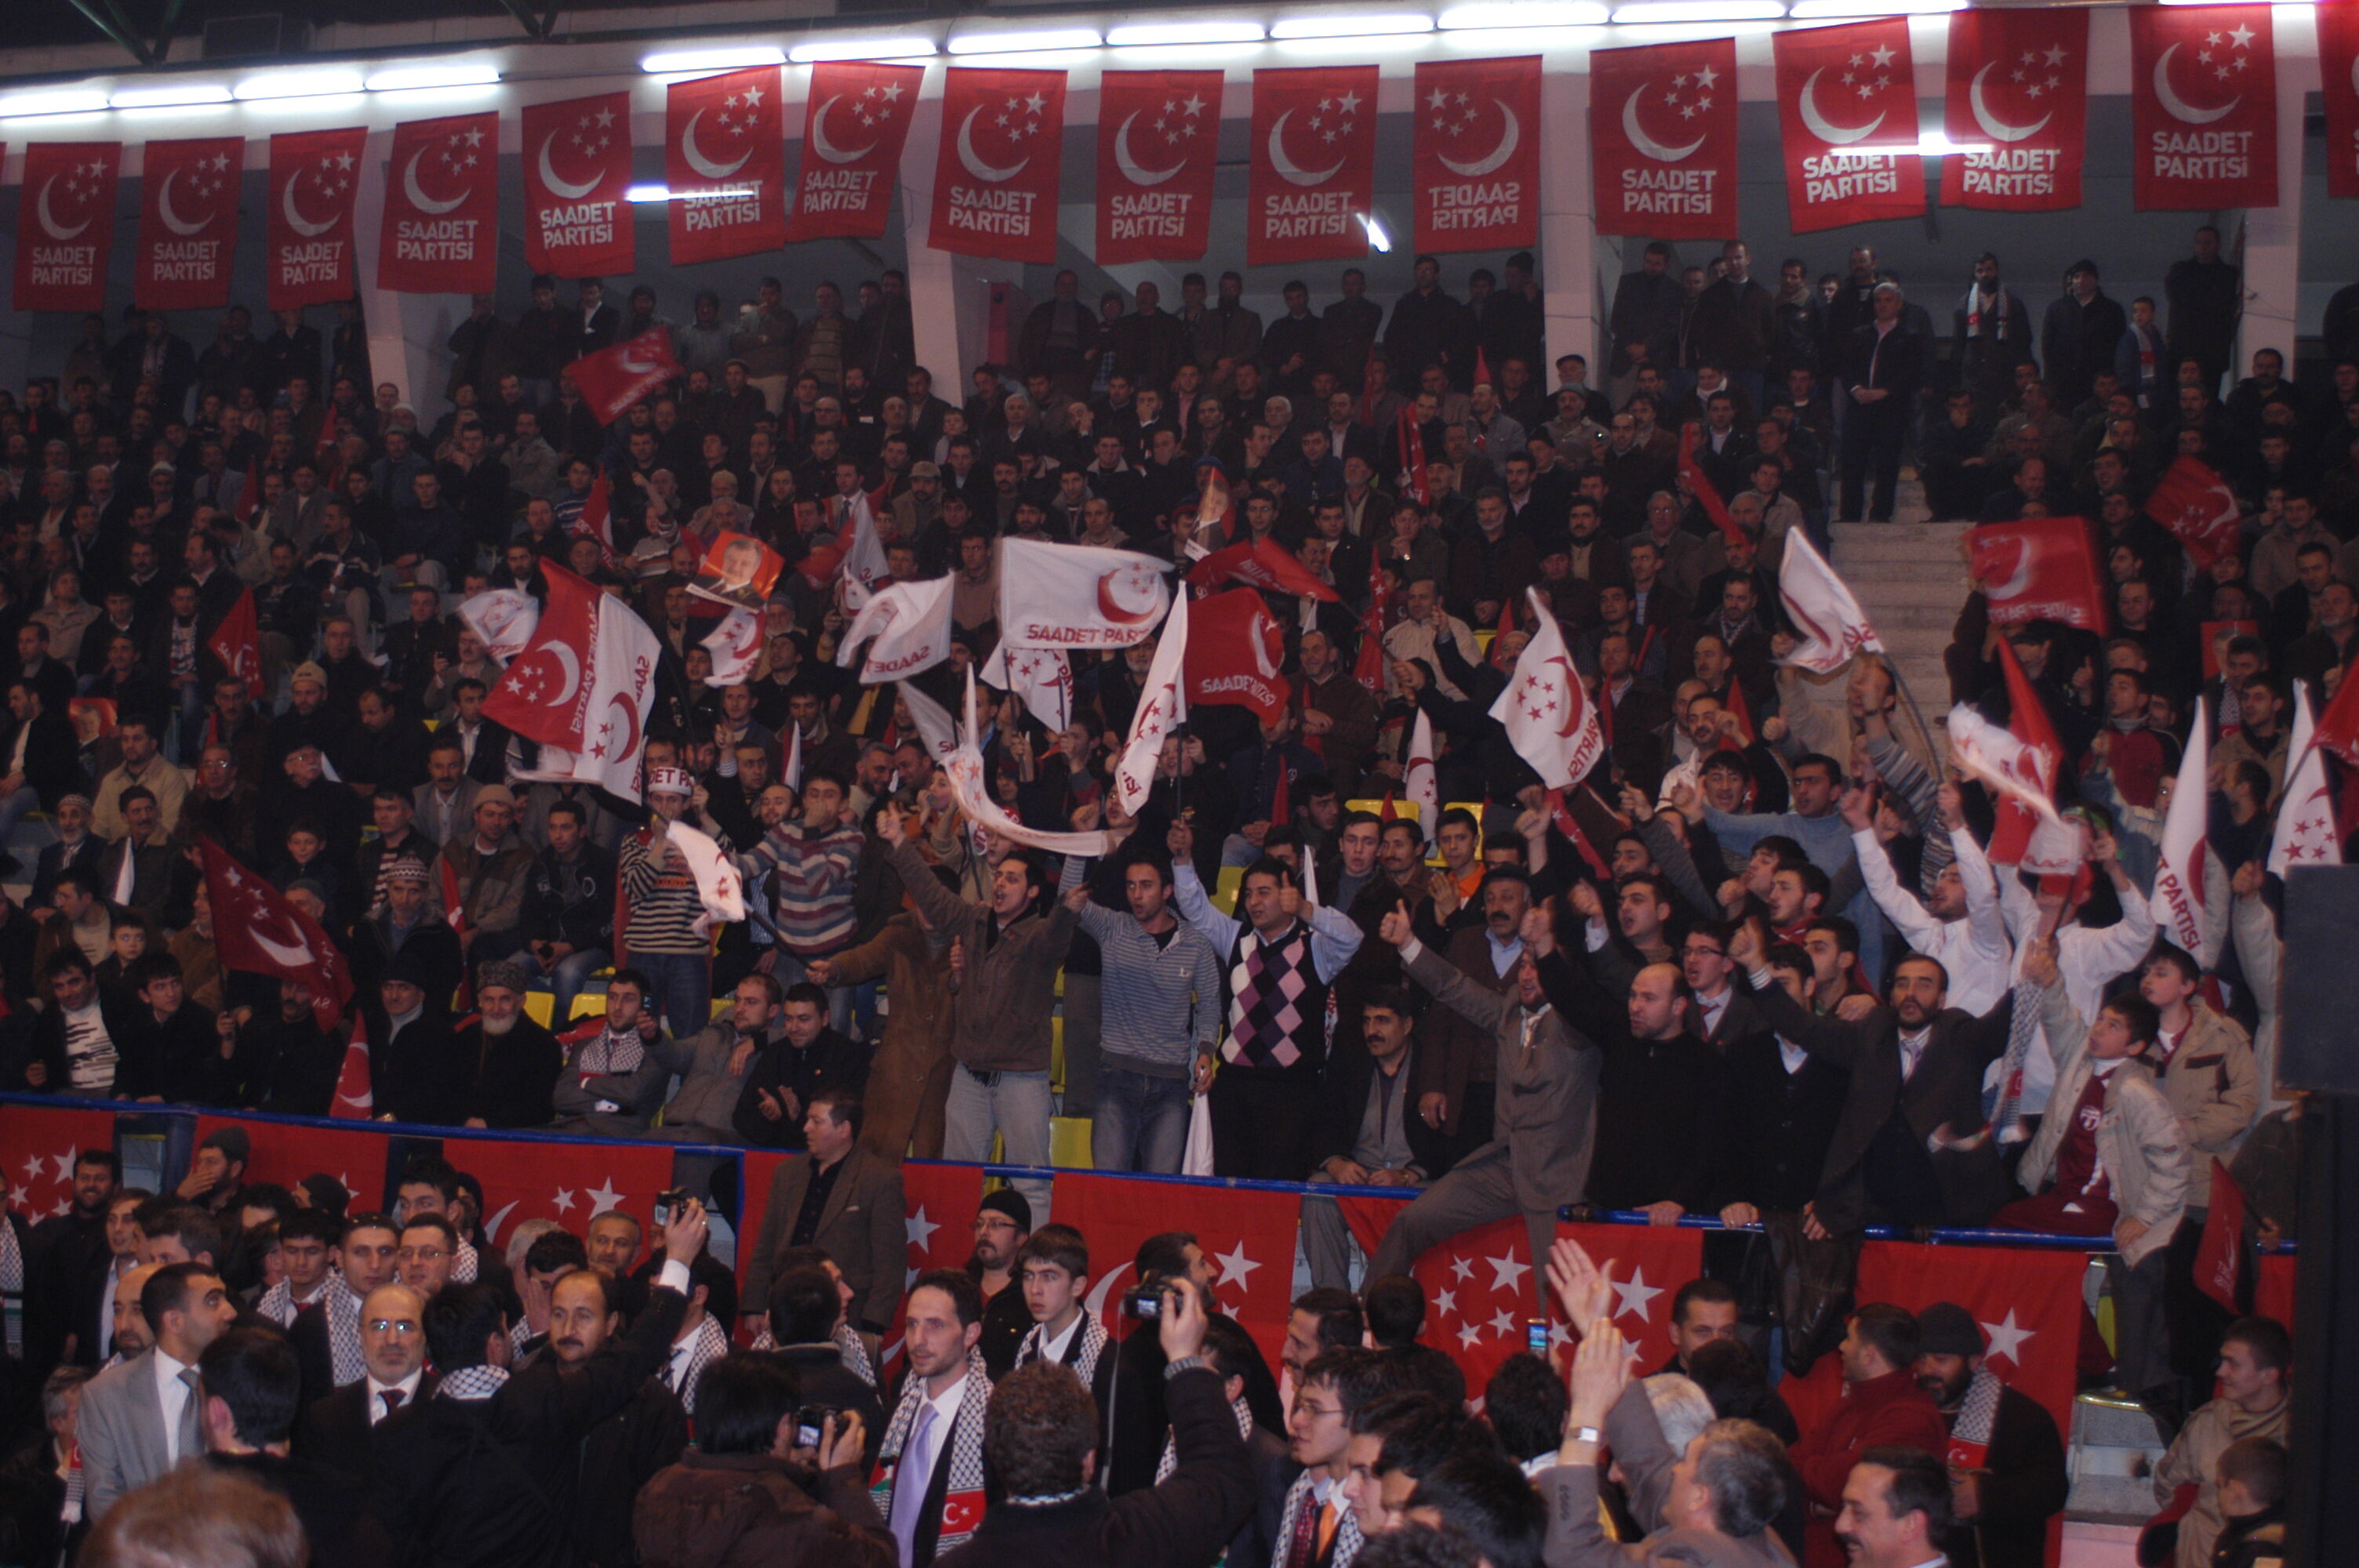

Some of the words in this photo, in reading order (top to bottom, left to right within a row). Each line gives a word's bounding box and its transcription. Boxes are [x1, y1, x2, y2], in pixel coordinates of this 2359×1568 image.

[2153, 130, 2252, 154] SAADET
[1803, 154, 1896, 180] SAADET
[1964, 149, 2061, 172] SAADET
[804, 169, 878, 192] SAADET
[1622, 168, 1717, 192] SAADET
[950, 186, 1037, 214] SAADET
[1111, 194, 1192, 216] SAADET
[1266, 191, 1353, 216] SAADET
[540, 201, 616, 229] SAADET
[398, 220, 478, 240] SAADET
[33, 246, 96, 265] SAADET
[154, 241, 220, 261] SAADET
[1027, 624, 1100, 644] SAADET
